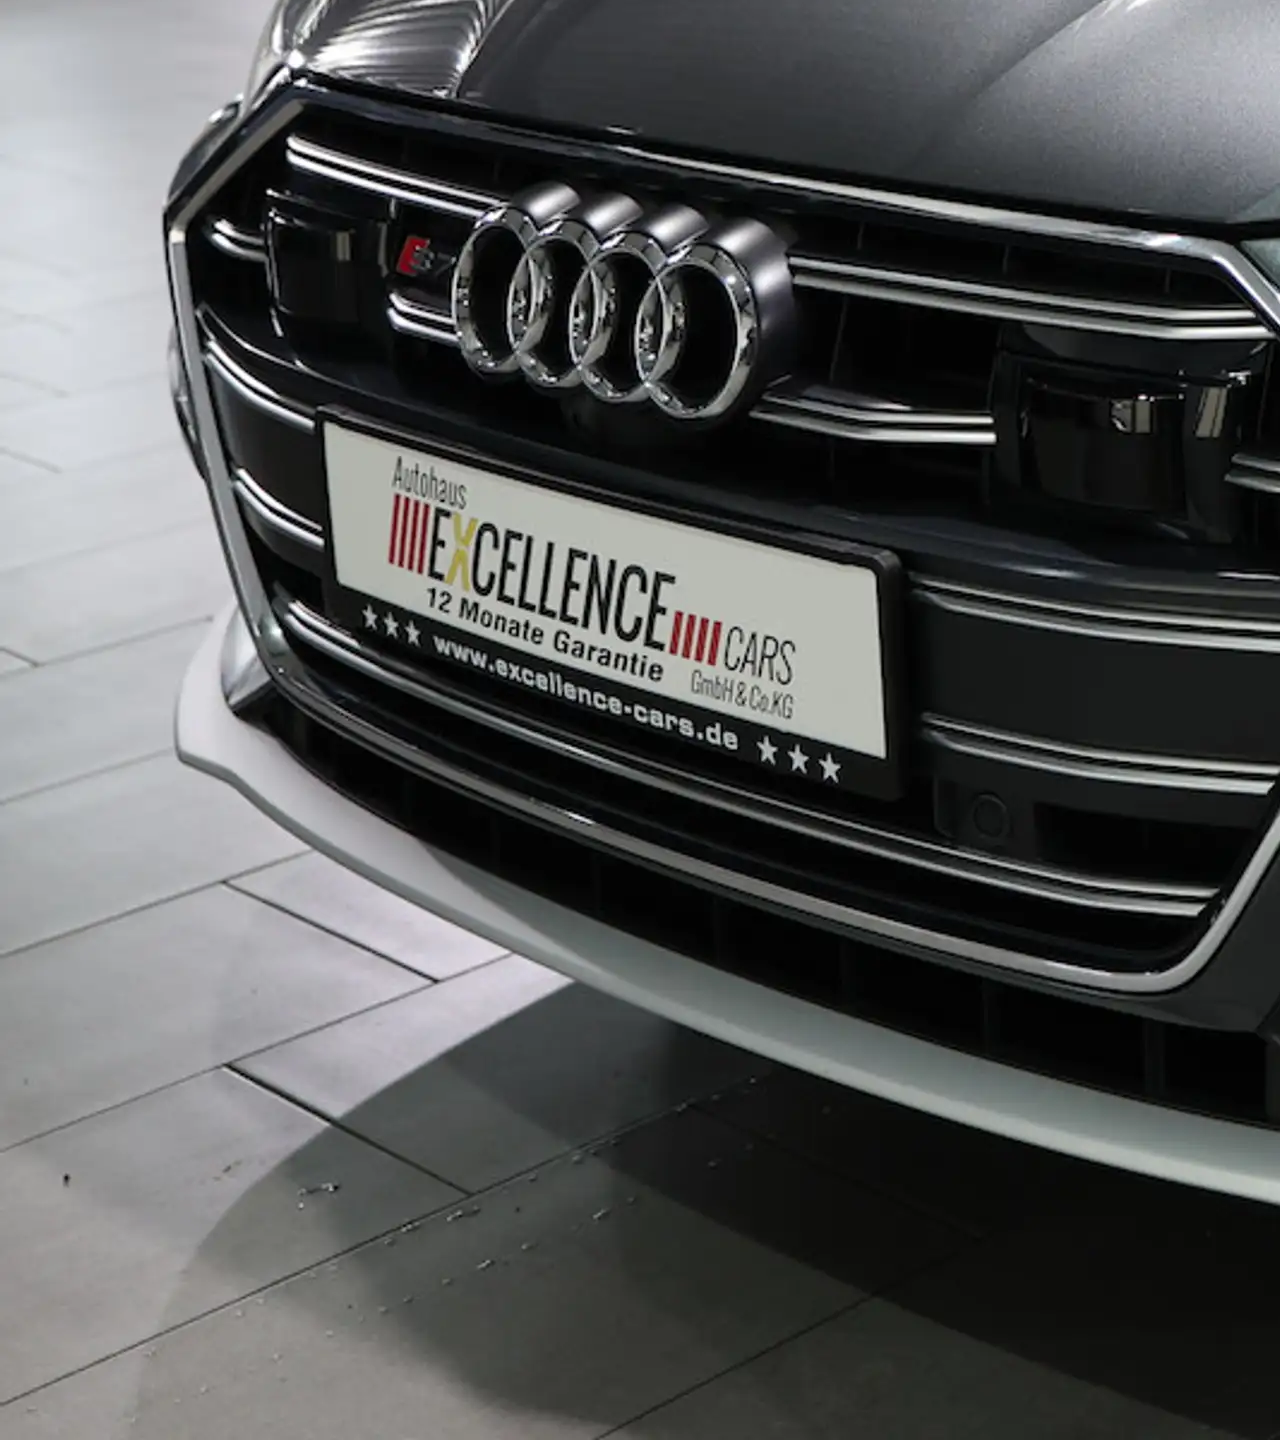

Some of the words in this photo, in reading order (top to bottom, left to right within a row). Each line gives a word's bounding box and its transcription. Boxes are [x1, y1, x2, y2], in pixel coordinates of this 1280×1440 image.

[392, 455, 467, 509] Autohaus
[426, 587, 452, 615] 12
[458, 597, 545, 646] Monate
[553, 629, 664, 683] Garantie
[427, 506, 676, 653] EXCELLENCE
[724, 625, 796, 686] CARS
[432, 632, 739, 752] www.excellence-cars.de
